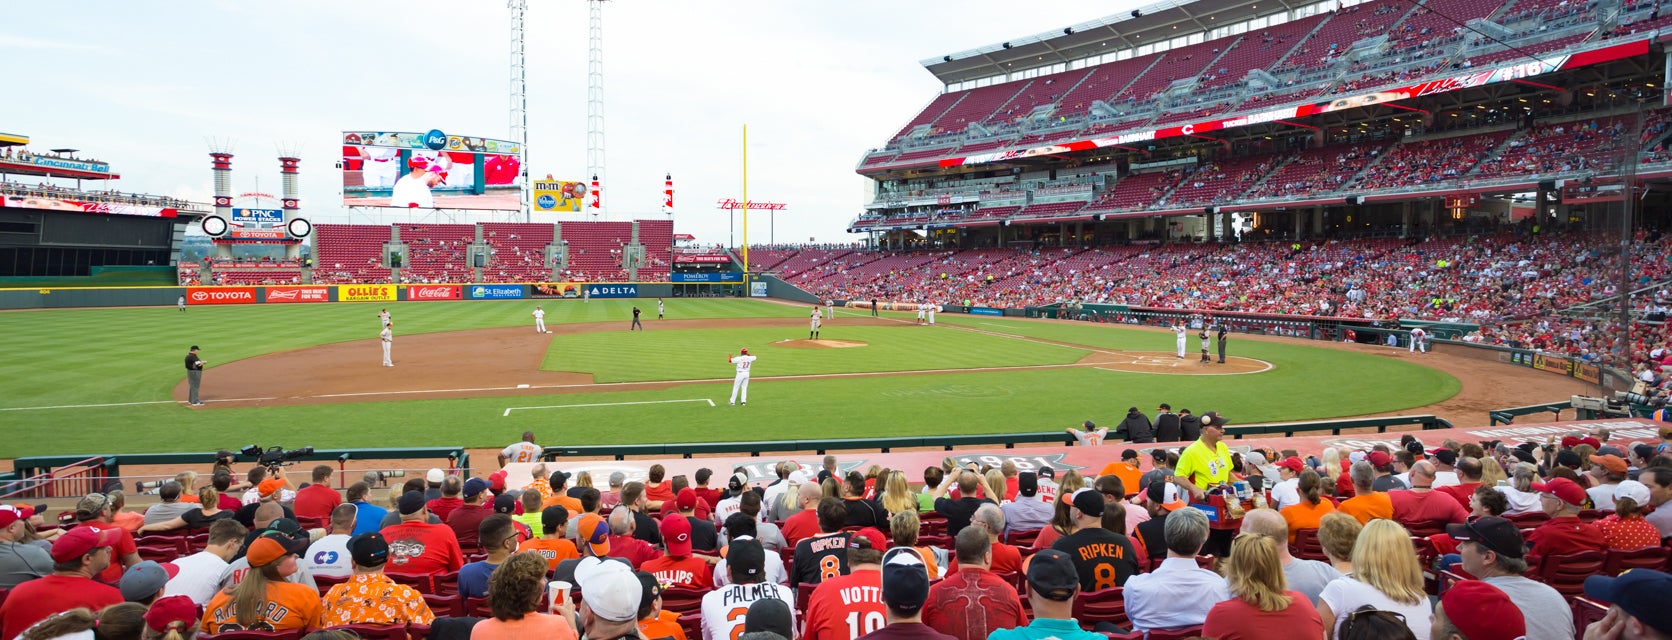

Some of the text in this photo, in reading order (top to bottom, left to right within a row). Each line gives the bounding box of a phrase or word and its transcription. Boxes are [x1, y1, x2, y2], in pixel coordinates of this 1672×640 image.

[1501, 62, 1542, 80] #16
[1223, 107, 1298, 128] TUCKER BARNHART
[429, 136, 445, 145] P&G
[34, 157, 110, 173] Cincinnati Bell
[251, 209, 275, 218] PNC
[348, 286, 388, 297] OLLIE'S
[493, 287, 521, 295] Elizabeth
[517, 451, 533, 463] 21
[1037, 485, 1056, 495] BENC
[810, 537, 846, 554] RIPKEN
[1078, 543, 1124, 561] RIPKEN
[820, 554, 840, 583] 8
[1094, 562, 1116, 592] 8
[652, 570, 694, 585] HILLIPS
[723, 583, 781, 607] PALMER
[840, 586, 884, 606] VOTT
[213, 600, 289, 624] RICARD
